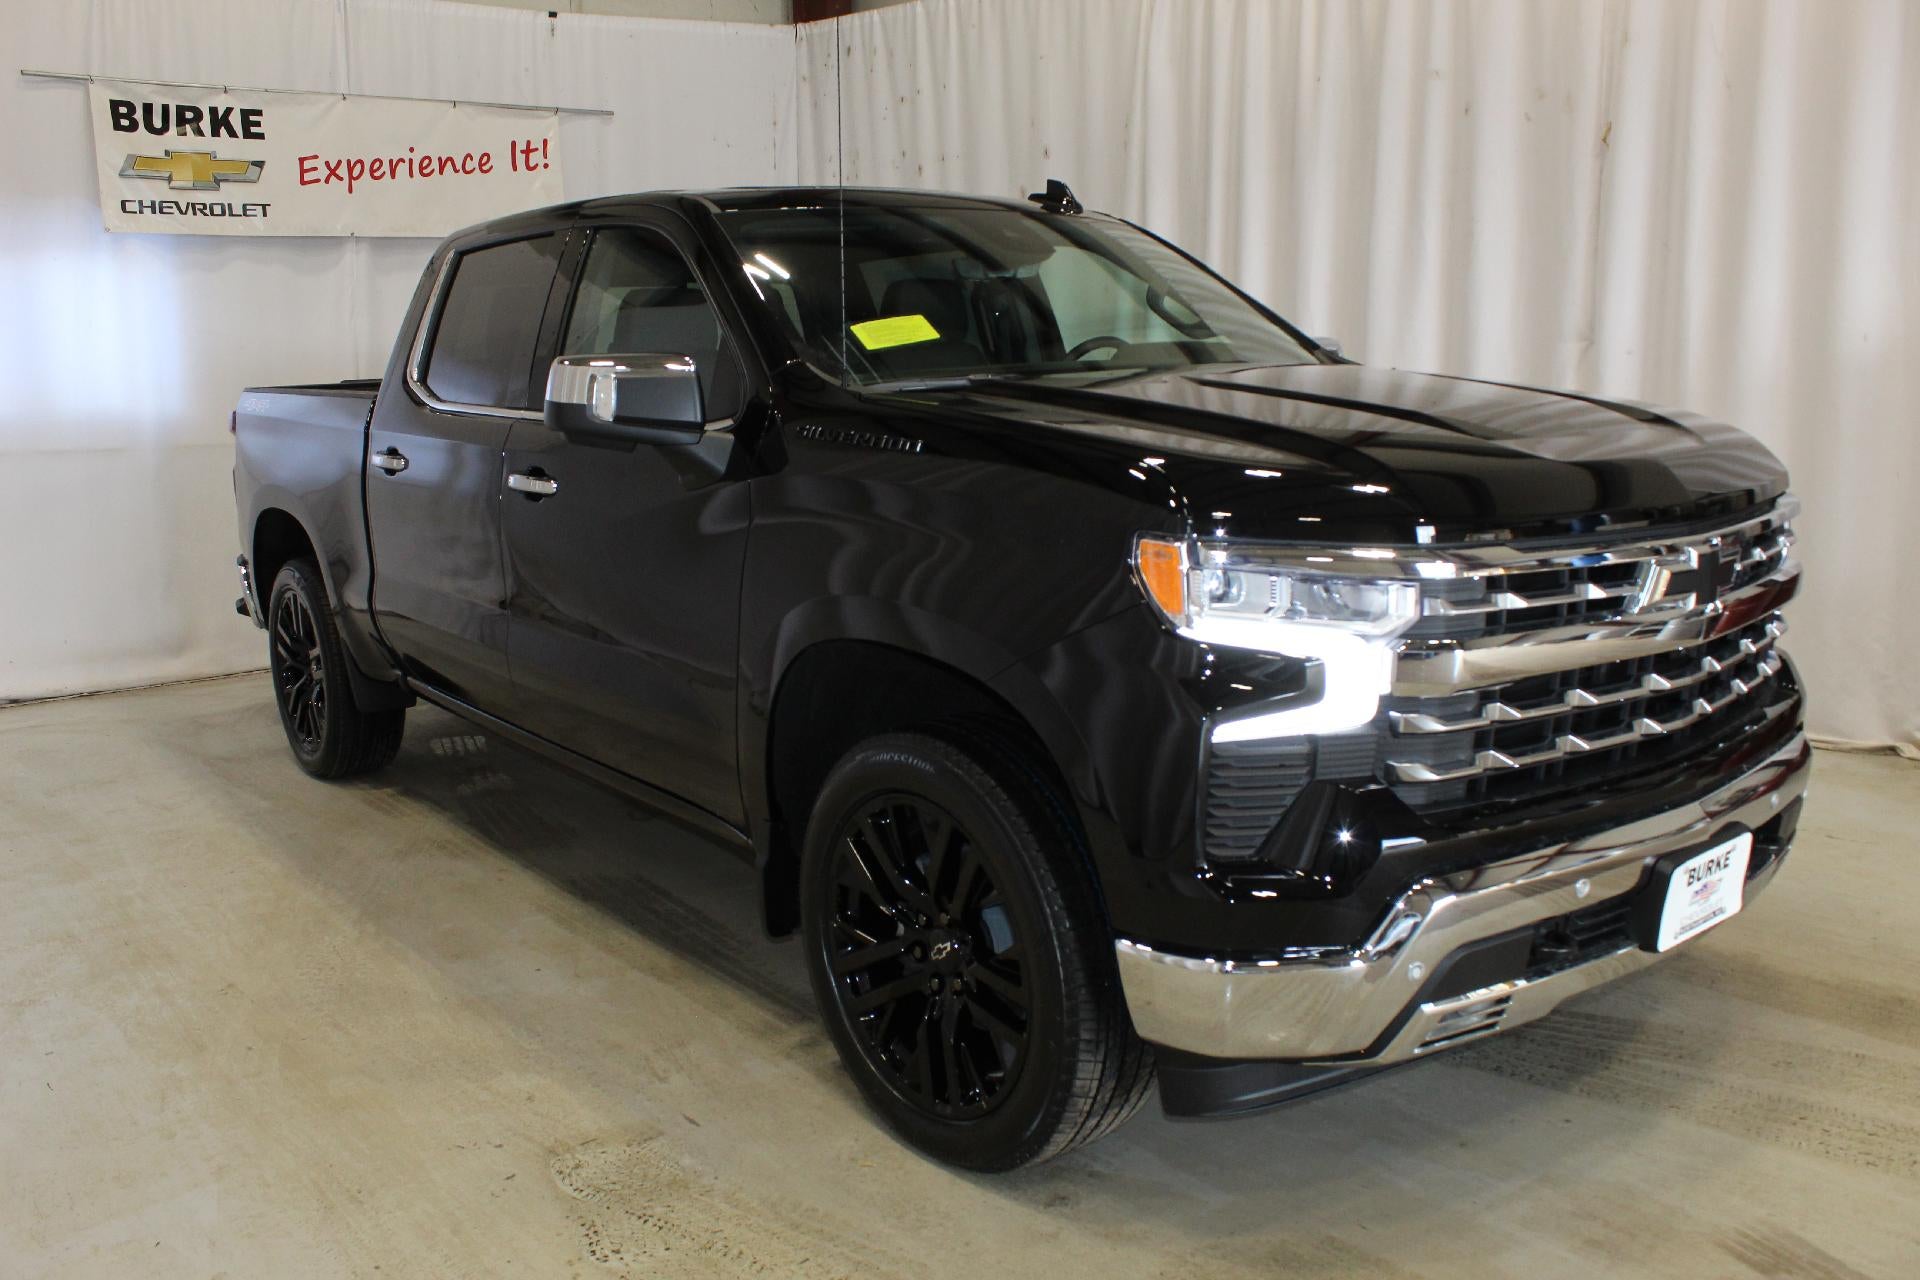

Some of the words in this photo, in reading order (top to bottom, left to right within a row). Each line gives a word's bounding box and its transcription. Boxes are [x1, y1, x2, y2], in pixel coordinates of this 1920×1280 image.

[109, 99, 265, 140] BURKE
[298, 146, 494, 194] Experience
[510, 138, 551, 172] It!
[120, 199, 271, 218] CHEVROLET
[1686, 850, 1733, 887] BURKE
